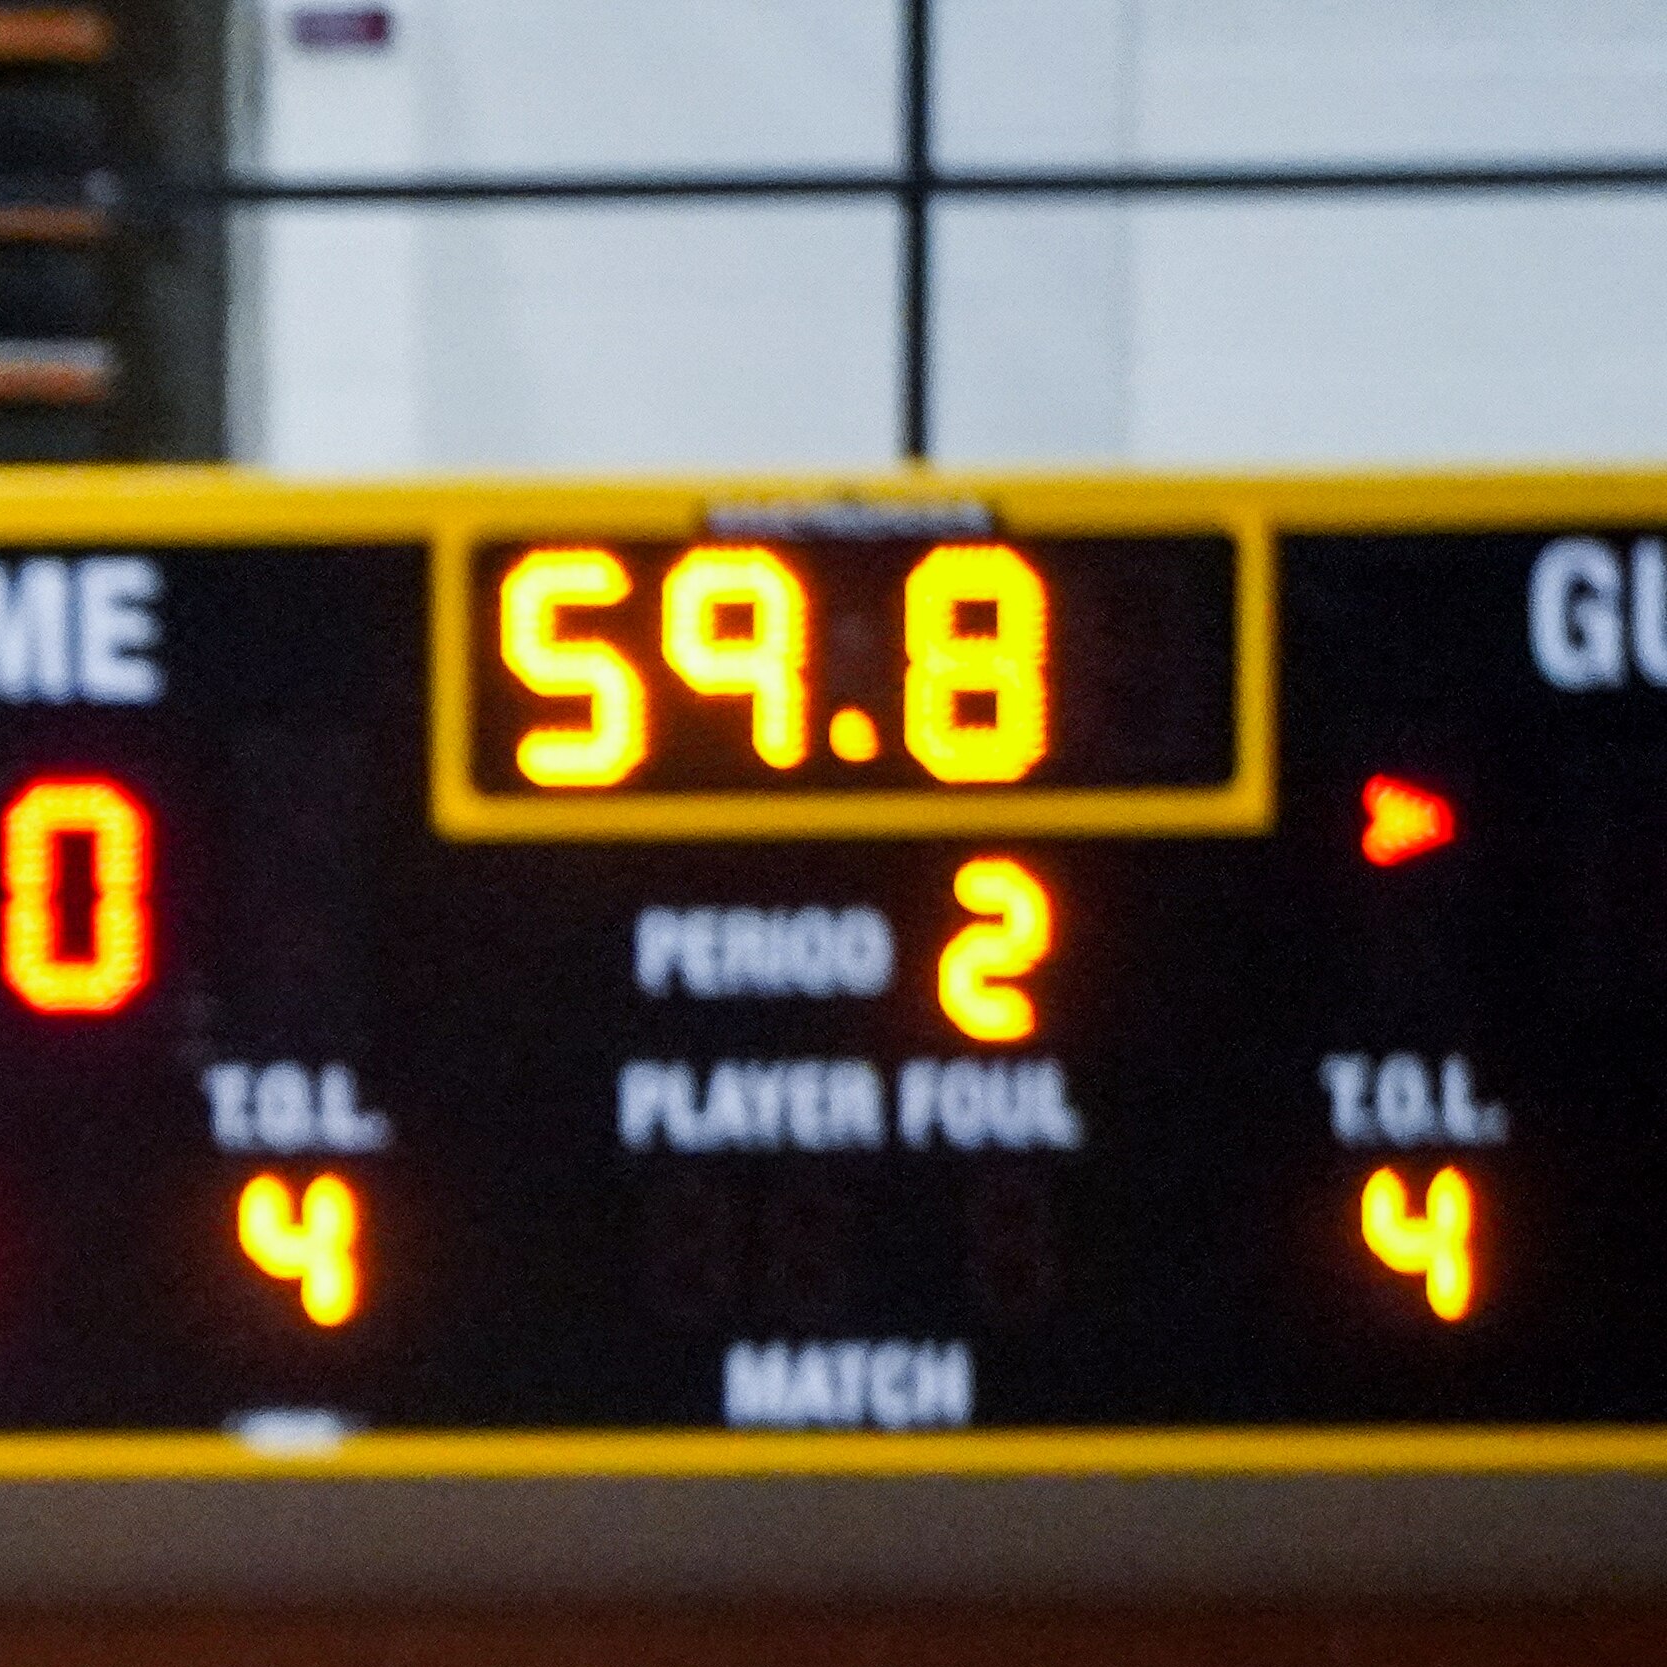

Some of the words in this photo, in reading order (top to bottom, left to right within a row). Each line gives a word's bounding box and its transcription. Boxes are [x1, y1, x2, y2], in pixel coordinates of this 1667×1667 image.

[499, 543, 1048, 786] 59.8
[0, 775, 152, 1016] 0
[635, 907, 895, 994] PERIOD
[935, 855, 1053, 1042] 2
[619, 1061, 881, 1149] PLAYER
[899, 1058, 1080, 1149] FOUL
[237, 1172, 360, 1326] 4
[1360, 1165, 1473, 1321] 4
[724, 1341, 972, 1427] MATCH
